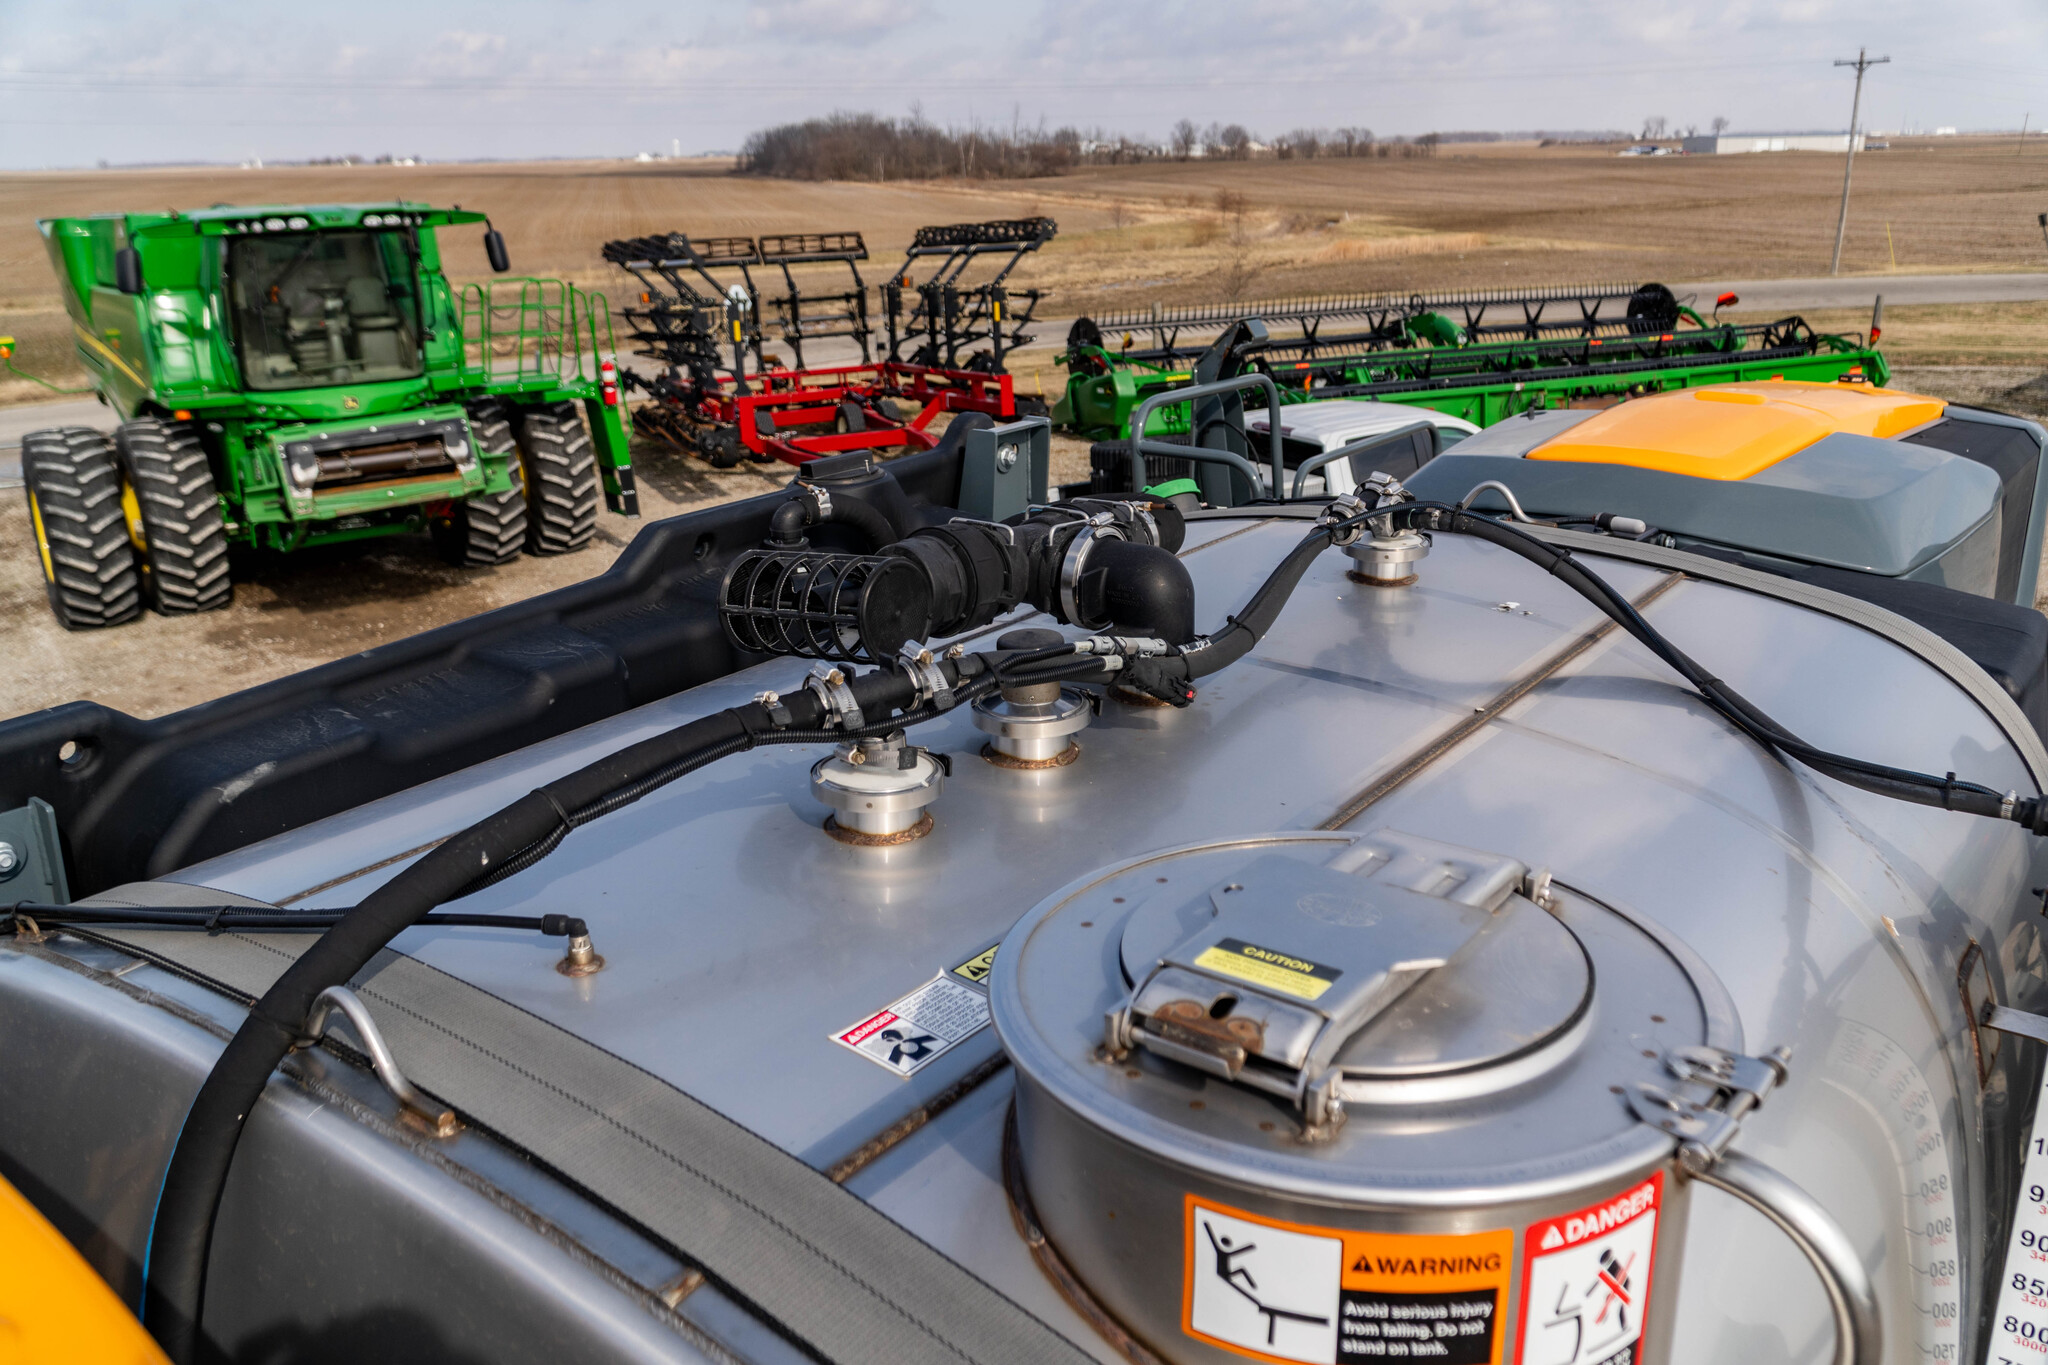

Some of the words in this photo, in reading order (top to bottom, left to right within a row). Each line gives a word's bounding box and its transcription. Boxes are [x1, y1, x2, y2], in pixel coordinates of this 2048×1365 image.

[1243, 946, 1314, 973] CAUTION
[855, 1013, 896, 1037] DANGER
[1565, 1183, 1655, 1243] DANGER
[1376, 1253, 1501, 1276] WARNING
[1342, 1300, 1390, 1319] Avoid
[1390, 1303, 1449, 1320] serious
[1449, 1301, 1494, 1320] injury
[1341, 1318, 1380, 1337] from
[1380, 1320, 1433, 1340] falling.
[1433, 1321, 1458, 1337] Do
[1458, 1320, 1486, 1336] not
[1340, 1338, 1386, 1356] stand
[1386, 1341, 1409, 1356] on
[1409, 1340, 1449, 1356] tank.
[2013, 1335, 2047, 1354] 3000
